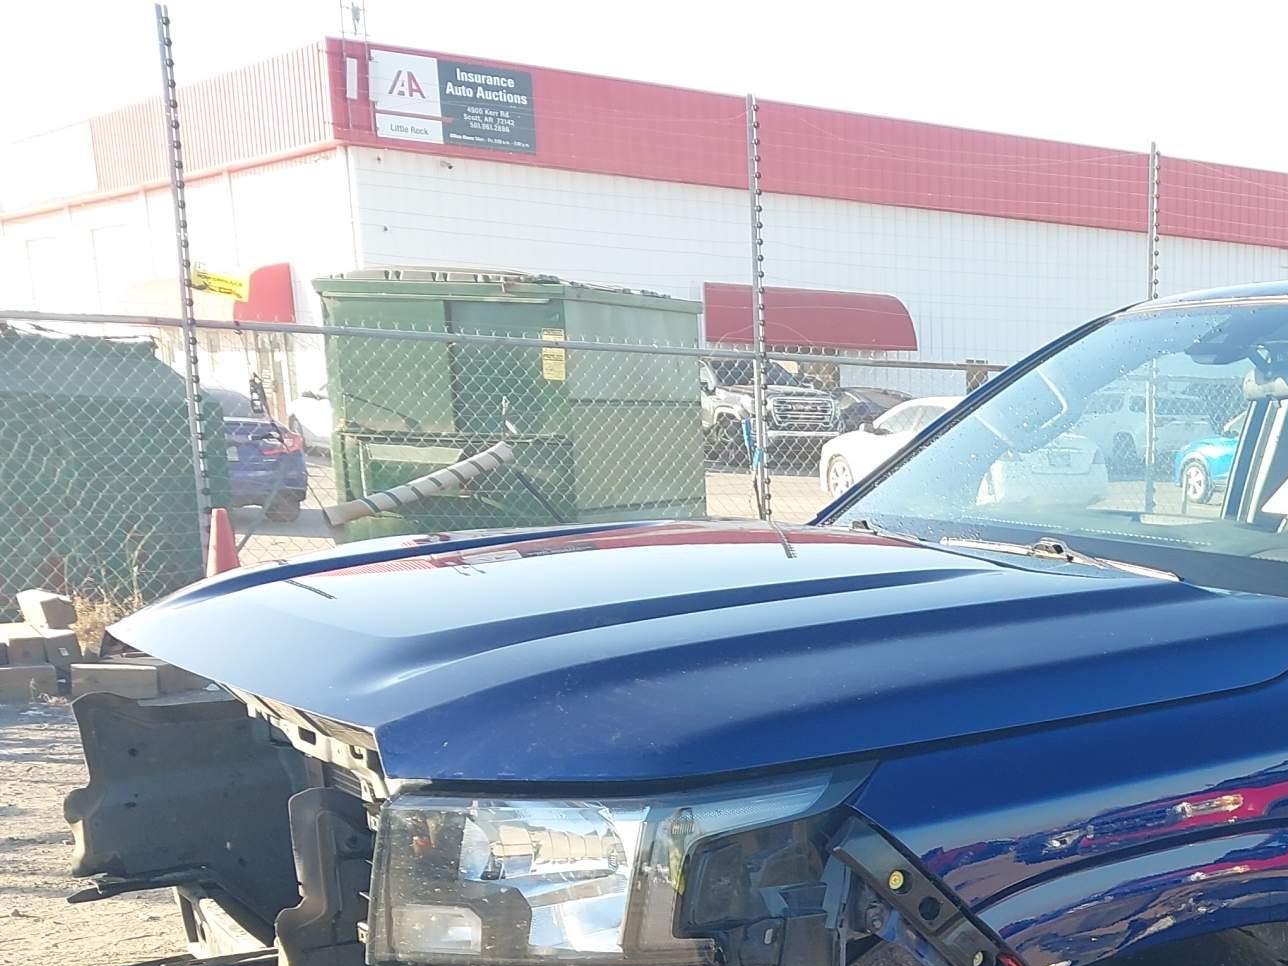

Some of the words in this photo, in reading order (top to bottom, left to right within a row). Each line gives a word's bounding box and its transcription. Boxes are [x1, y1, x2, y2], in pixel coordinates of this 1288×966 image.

[456, 68, 515, 88] Insurance
[446, 82, 473, 97] Auto
[476, 85, 528, 105] Auctions
[390, 123, 409, 134] Little
[410, 124, 429, 135] Rock
